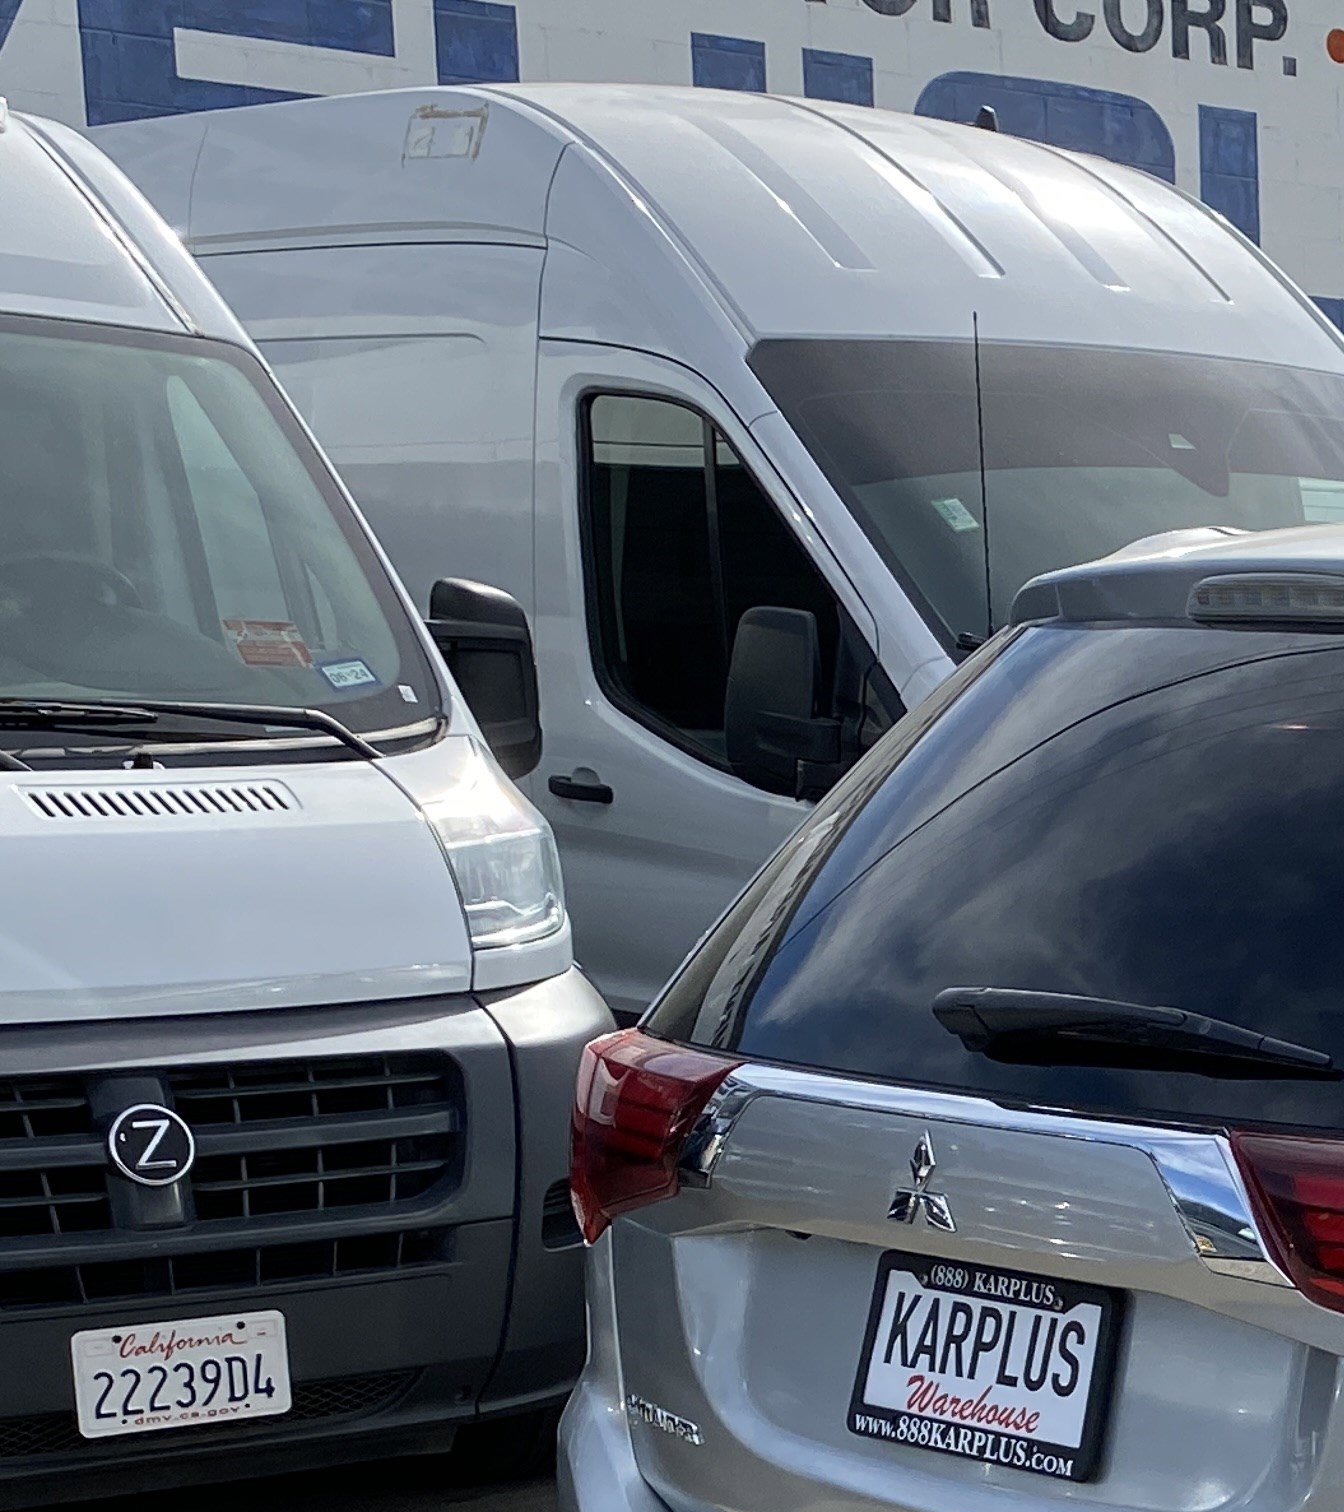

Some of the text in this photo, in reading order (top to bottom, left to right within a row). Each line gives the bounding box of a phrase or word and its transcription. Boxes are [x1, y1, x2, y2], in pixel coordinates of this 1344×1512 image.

[929, 1264, 1055, 1306] (888) KARPLUS
[118, 1329, 248, 1361] California
[883, 1291, 1086, 1398] KARPLUS
[93, 1353, 276, 1420] 22239D4
[906, 1374, 1041, 1434] Warehouse
